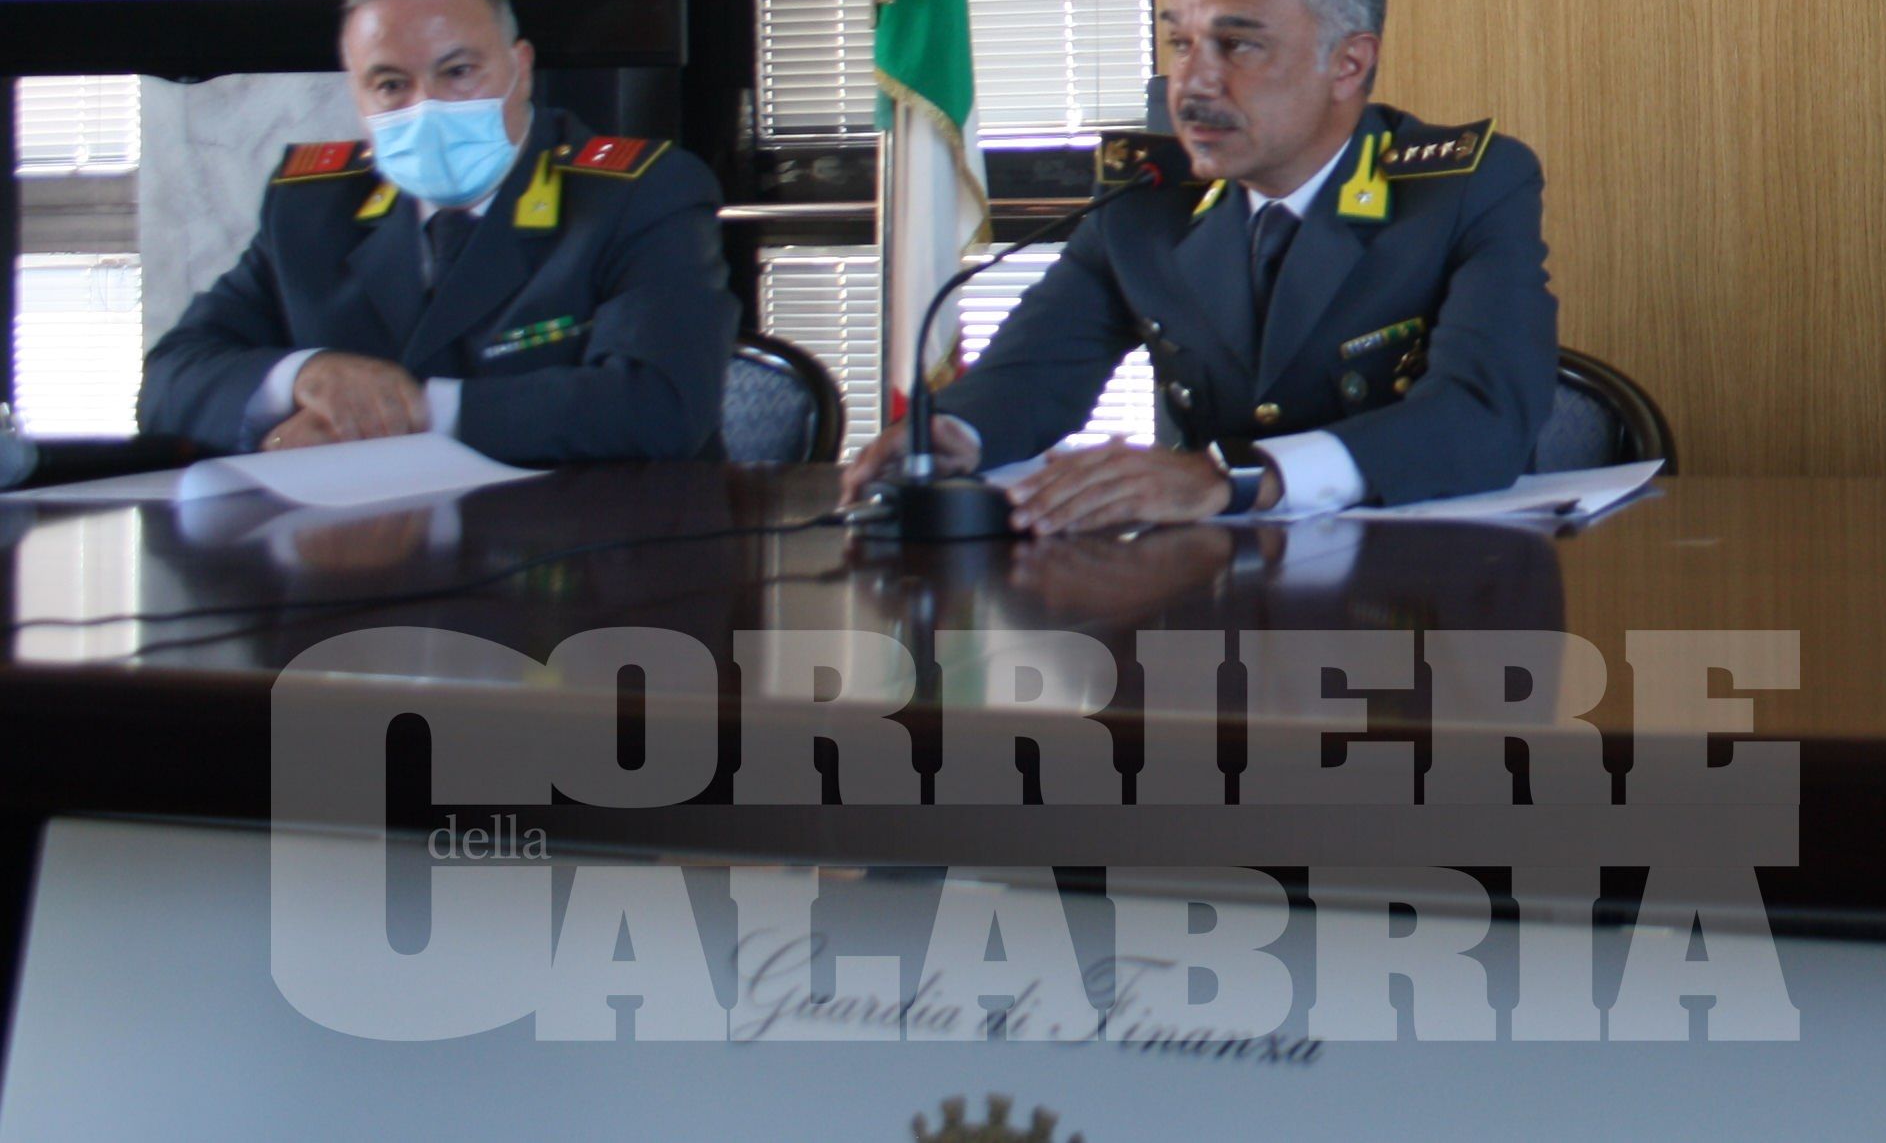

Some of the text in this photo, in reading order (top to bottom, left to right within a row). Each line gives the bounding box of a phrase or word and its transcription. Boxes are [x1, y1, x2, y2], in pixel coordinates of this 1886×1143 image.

[731, 928, 1325, 1068] Guardia di Finanza
